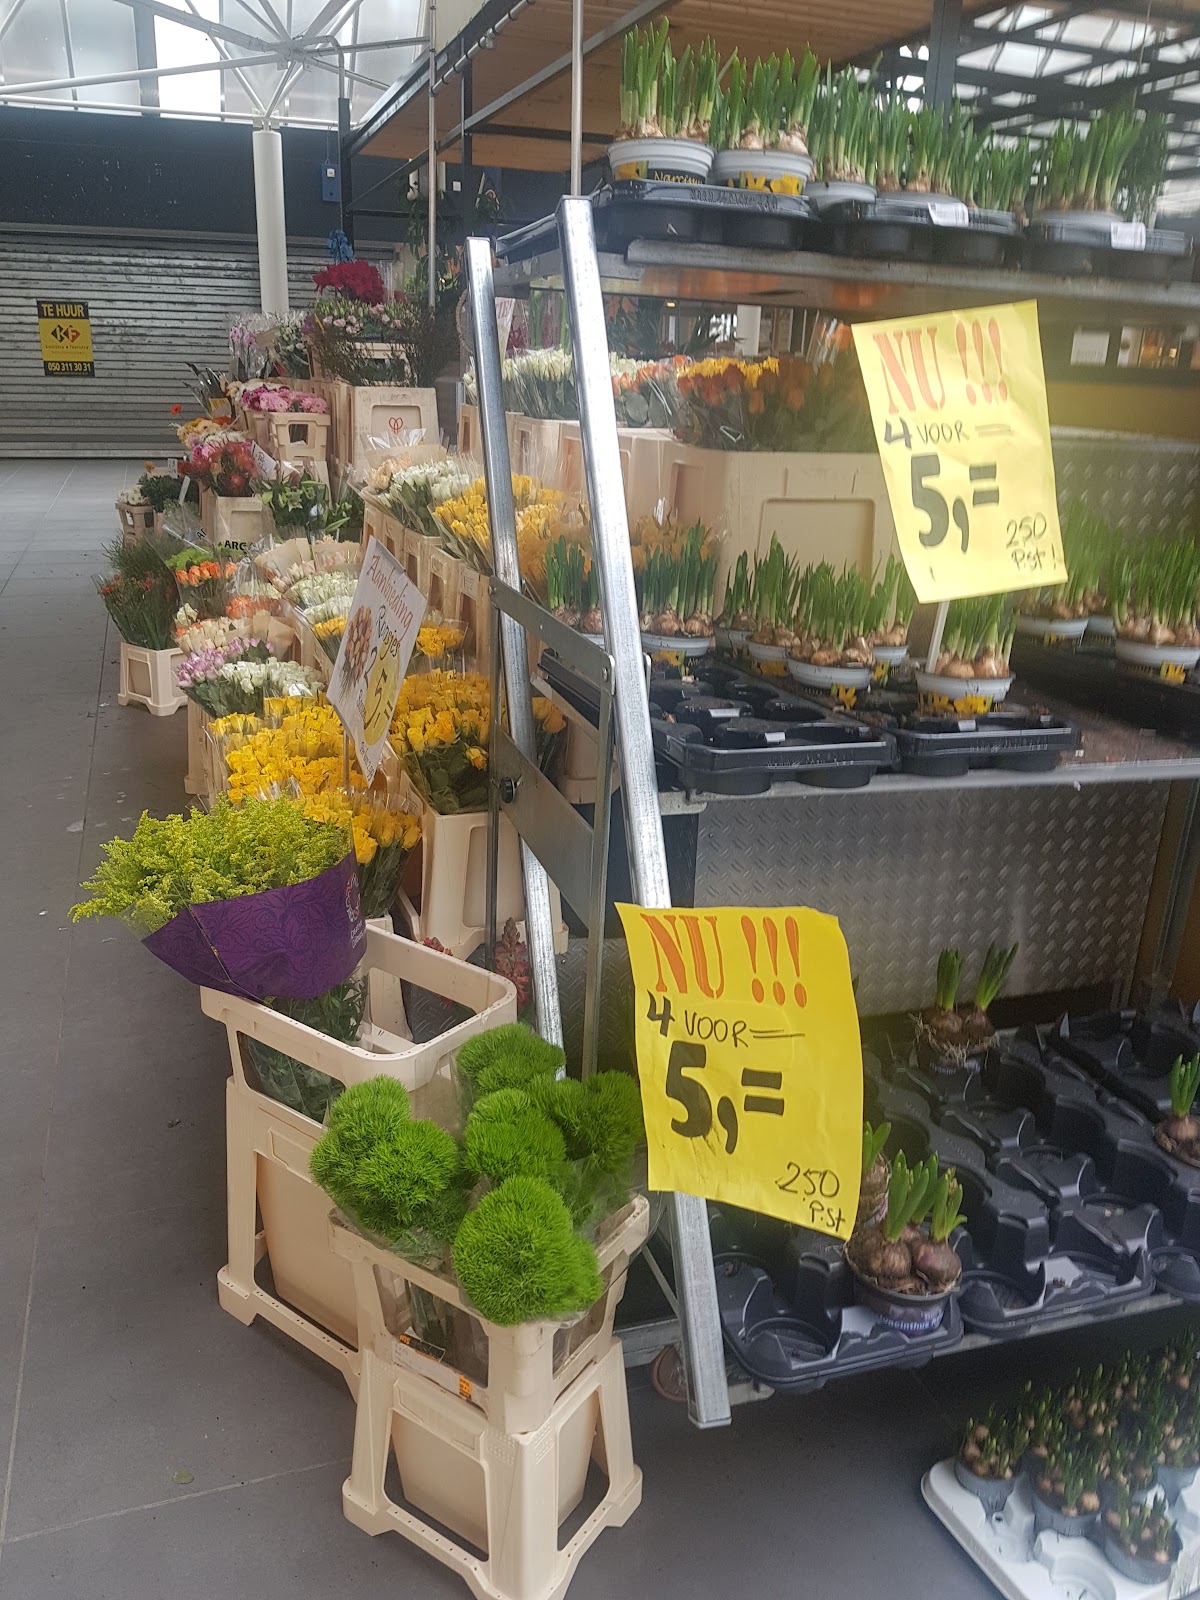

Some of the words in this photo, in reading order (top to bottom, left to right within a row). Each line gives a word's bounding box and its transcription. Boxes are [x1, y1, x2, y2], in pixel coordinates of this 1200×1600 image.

[42, 304, 54, 317] TE
[56, 304, 85, 317] HUUR
[48, 362, 60, 371] 050
[61, 362, 73, 371] 311
[74, 362, 82, 371] 30
[83, 363, 91, 371] 31
[872, 327, 946, 414] NU
[955, 317, 1008, 406] !!!
[884, 416, 912, 450] 4
[917, 419, 970, 445] VOOR
[366, 554, 414, 643] Aanbieding
[640, 913, 725, 1000] NU
[740, 914, 808, 1009] !!!
[646, 989, 676, 1038] 4
[684, 1009, 749, 1048] VOOR
